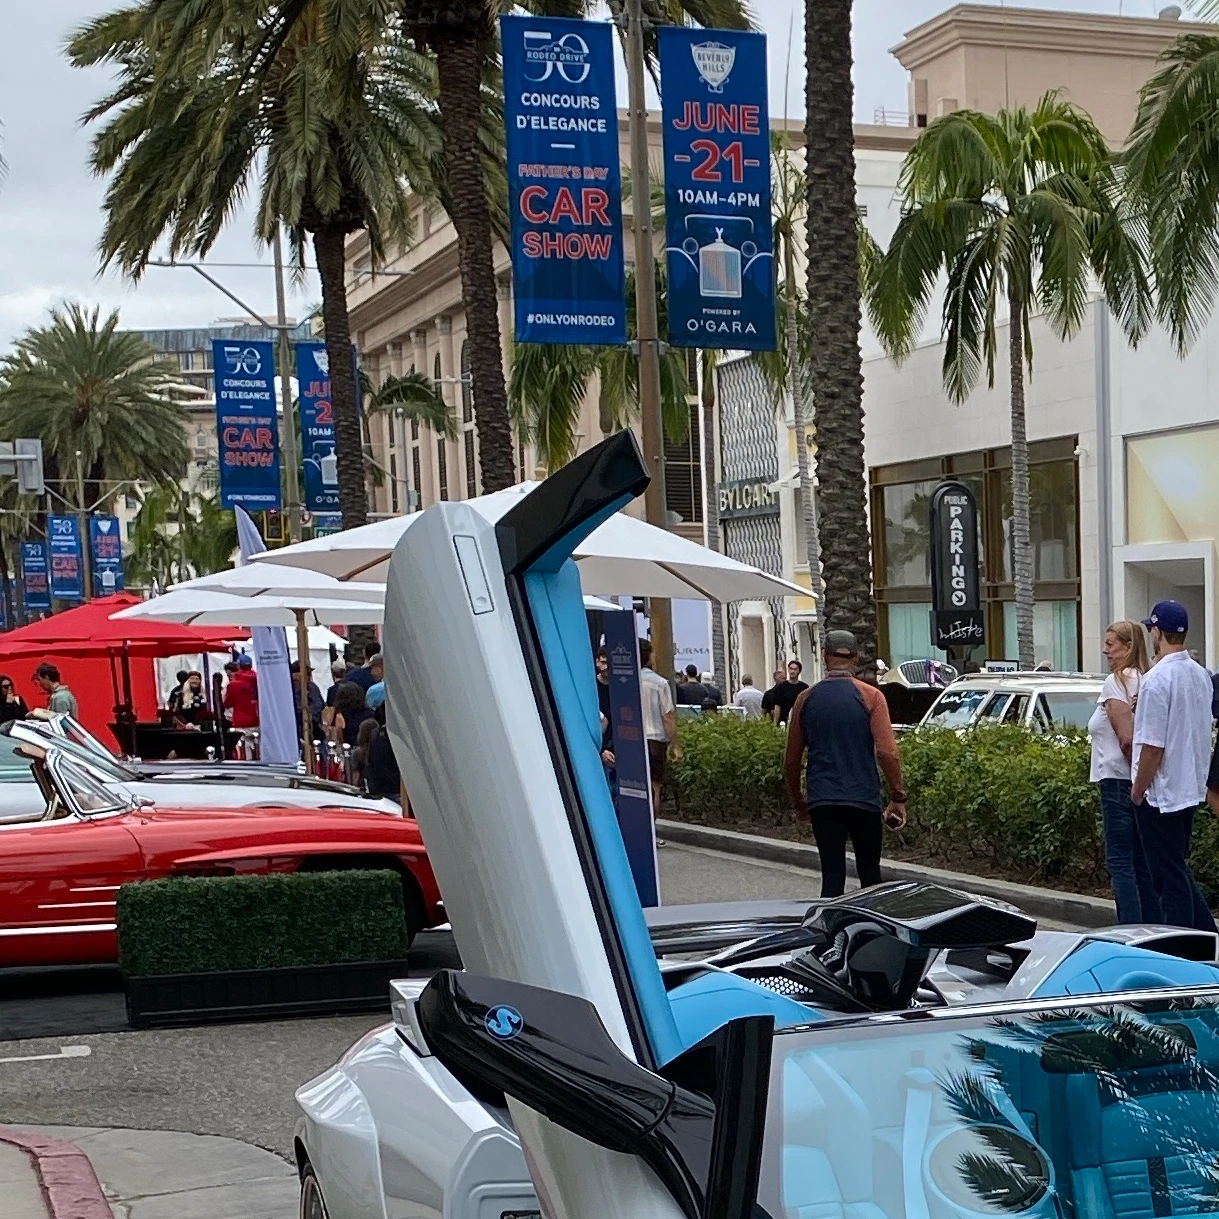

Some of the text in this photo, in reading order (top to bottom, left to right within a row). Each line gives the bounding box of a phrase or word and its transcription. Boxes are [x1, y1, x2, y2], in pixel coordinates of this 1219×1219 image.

[527, 51, 586, 62] RODEO DRIVE
[697, 52, 730, 63] BEVERLY
[703, 63, 725, 73] HILLS
[521, 92, 600, 109] CONCOURS
[516, 115, 607, 132] D'ELEGANCE
[672, 101, 760, 134] JUNE
[518, 163, 609, 180] FATHER'S DAY
[520, 186, 612, 226] CAR
[522, 231, 612, 260] SHOW
[527, 313, 615, 327] #ONLYONRODEO
[687, 319, 757, 334] O'GARA
[222, 379, 267, 388] CONCOURS
[304, 381, 331, 397] JU
[223, 427, 273, 448] CAR
[224, 451, 274, 467] SHOW
[315, 496, 339, 504] O'GA
[949, 505, 967, 590] PARKING
